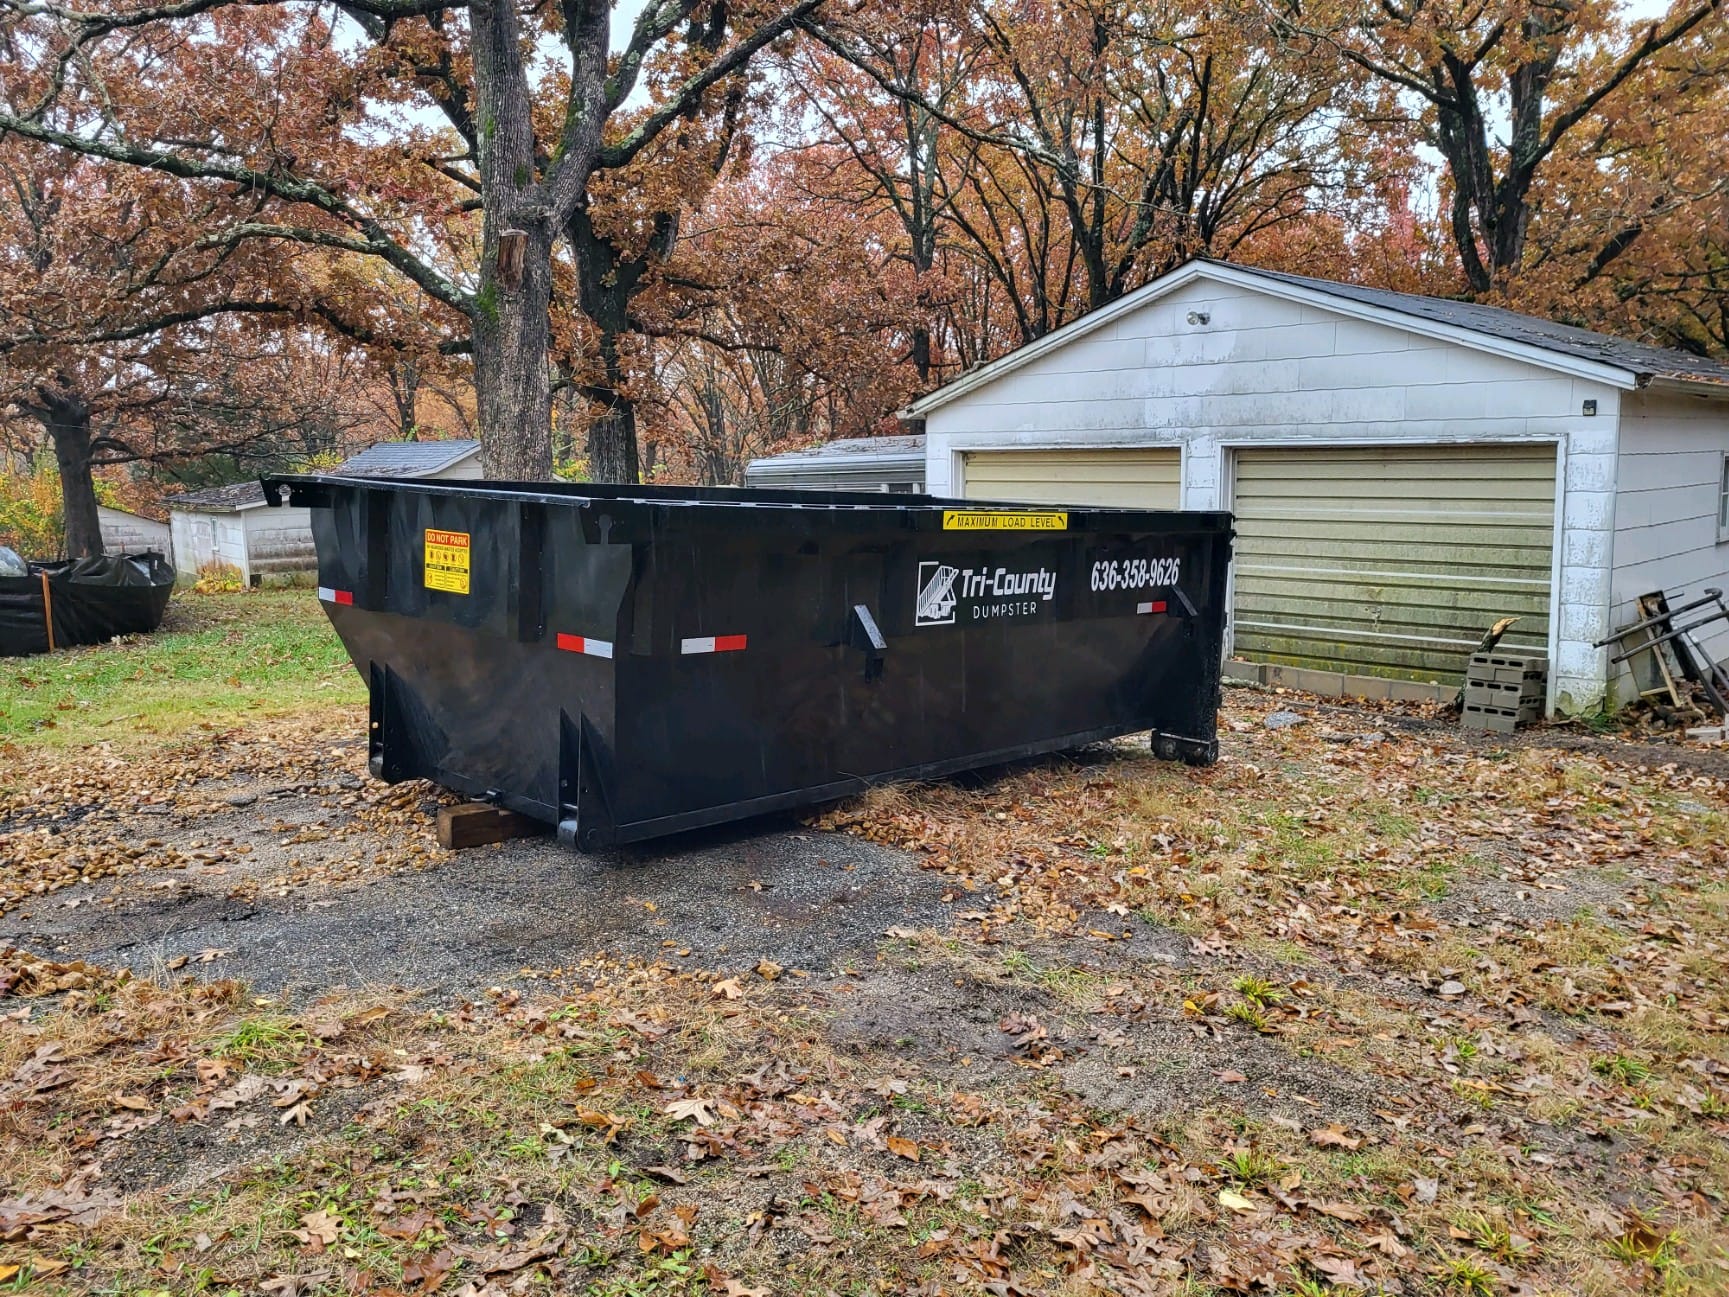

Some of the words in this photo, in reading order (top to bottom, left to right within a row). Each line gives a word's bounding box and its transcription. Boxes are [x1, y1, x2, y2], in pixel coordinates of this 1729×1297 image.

[957, 516, 998, 527] MAXIMUM
[1002, 517, 1026, 528] LOAD
[1030, 517, 1056, 528] LEVEL
[427, 532, 436, 542] DO
[436, 534, 449, 543] NOT
[450, 535, 468, 546] PARK
[962, 566, 1057, 601] Tri-County
[1091, 557, 1180, 592] 636-358-9626
[973, 601, 1037, 619] DUMPSTER
